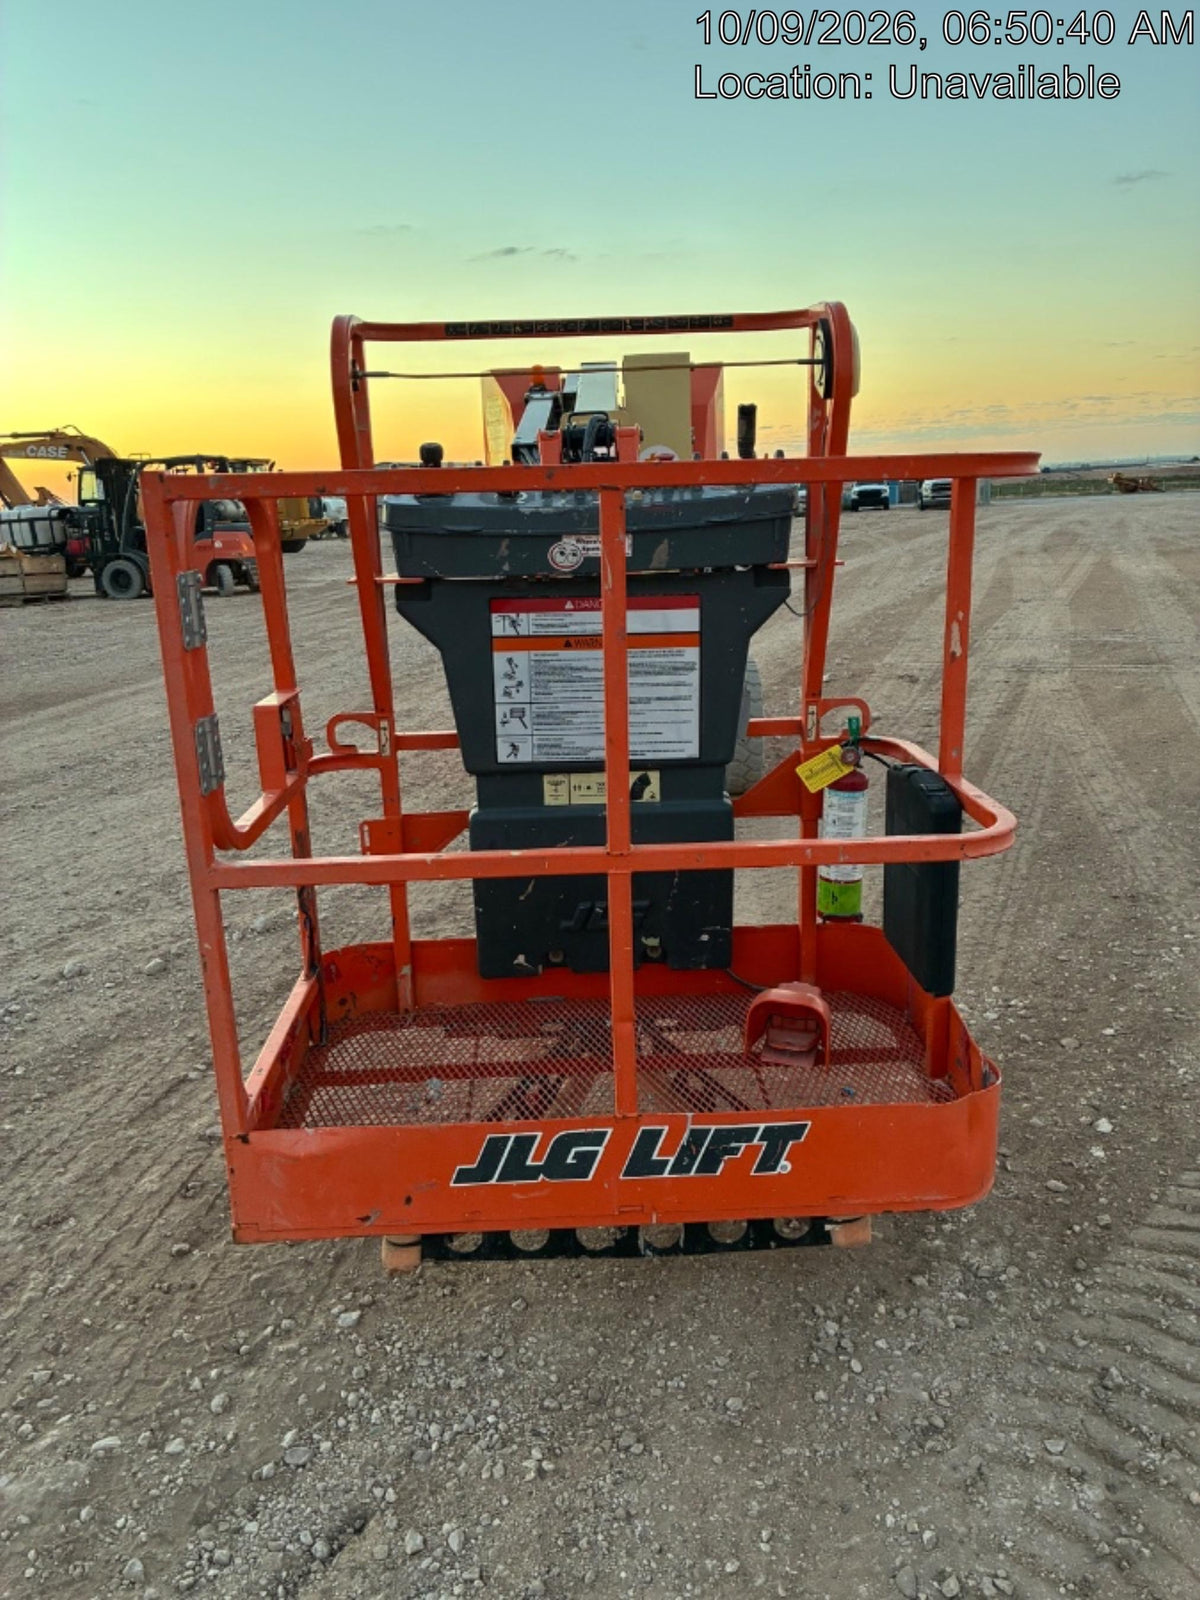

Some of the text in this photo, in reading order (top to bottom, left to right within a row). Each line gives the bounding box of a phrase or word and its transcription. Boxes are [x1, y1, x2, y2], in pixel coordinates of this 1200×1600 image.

[26, 444, 68, 459] CASE
[450, 1121, 811, 1187] JLG LIFT
